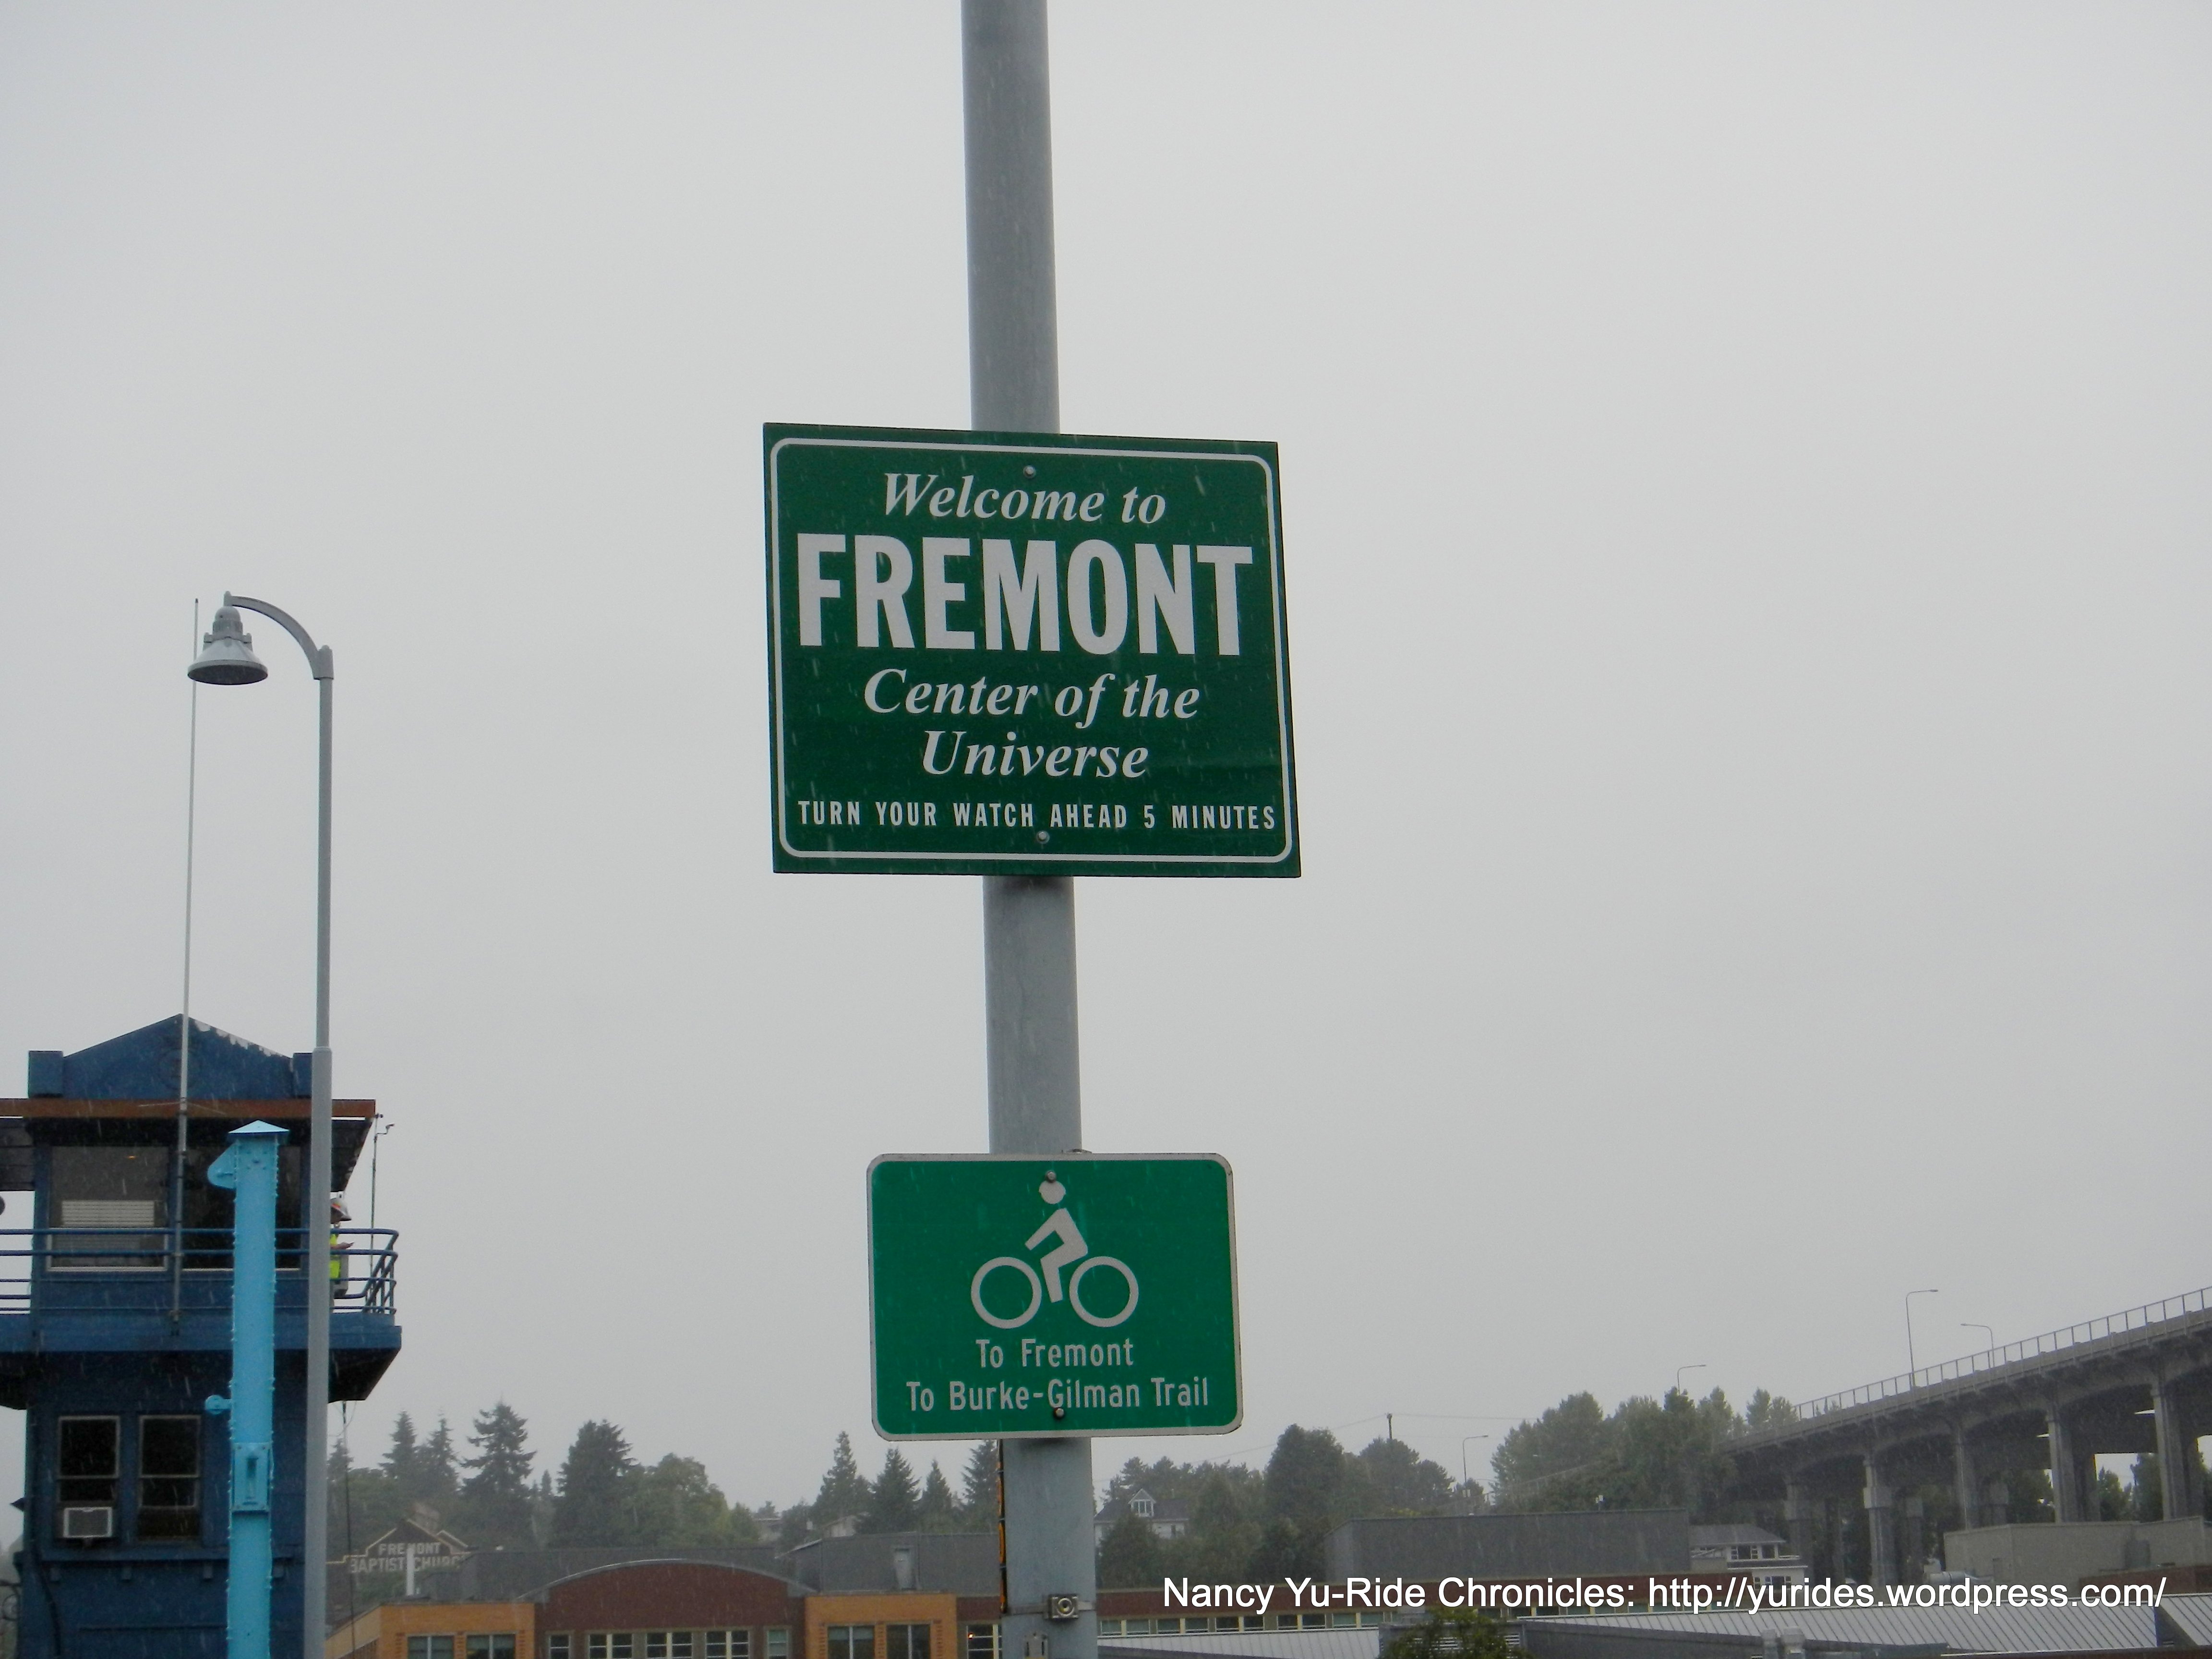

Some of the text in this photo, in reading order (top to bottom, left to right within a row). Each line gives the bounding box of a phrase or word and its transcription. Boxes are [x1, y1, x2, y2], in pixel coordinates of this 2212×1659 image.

[884, 473, 1166, 524] Welcome to
[797, 532, 1253, 656] FREMONT
[864, 668, 1200, 729] Center of the
[922, 730, 1149, 778] Universe
[798, 801, 1275, 830] TURN YOUR WATCH AHEAD 5 MINUTES
[976, 1338, 1133, 1368] To Fremont
[906, 1376, 1209, 1411] To Burke-Gilman Trail
